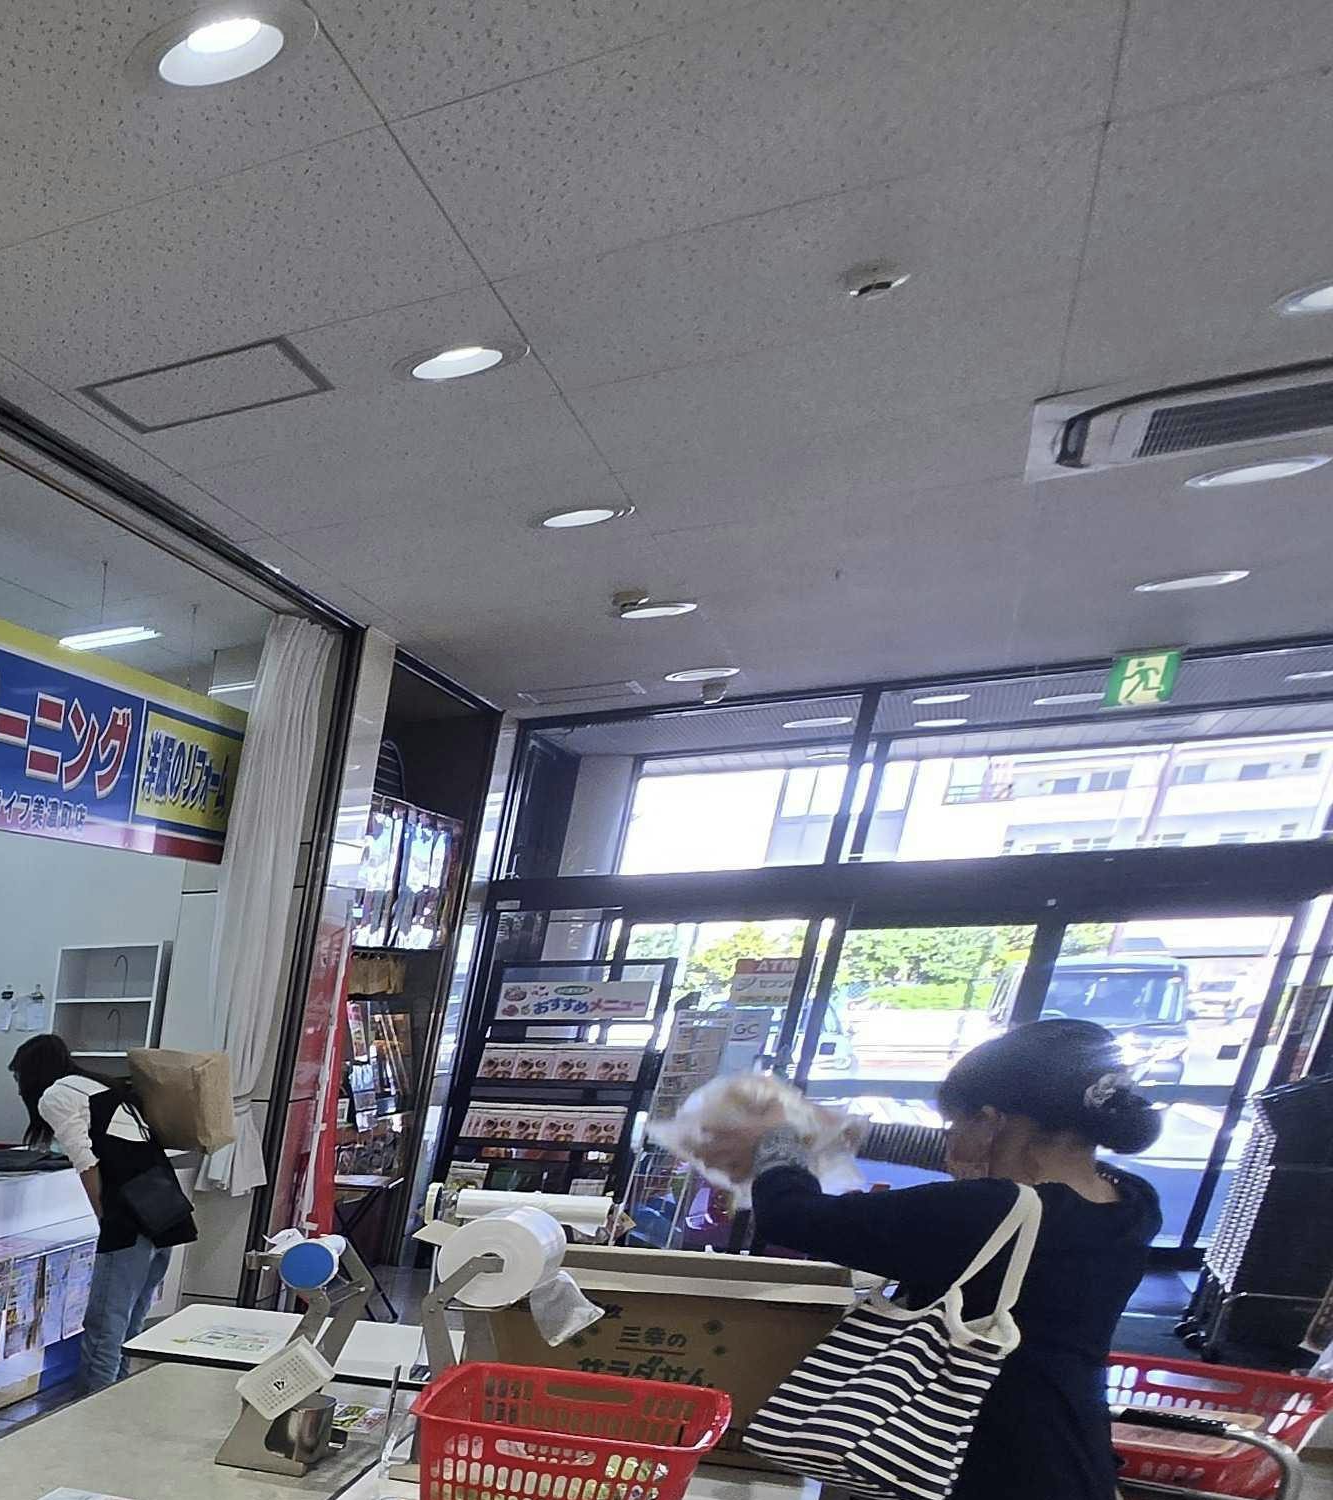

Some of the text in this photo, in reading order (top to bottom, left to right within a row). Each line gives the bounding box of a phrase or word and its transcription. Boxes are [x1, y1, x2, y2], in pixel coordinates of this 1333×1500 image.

[533, 997, 646, 1014] おすすめメニュー
